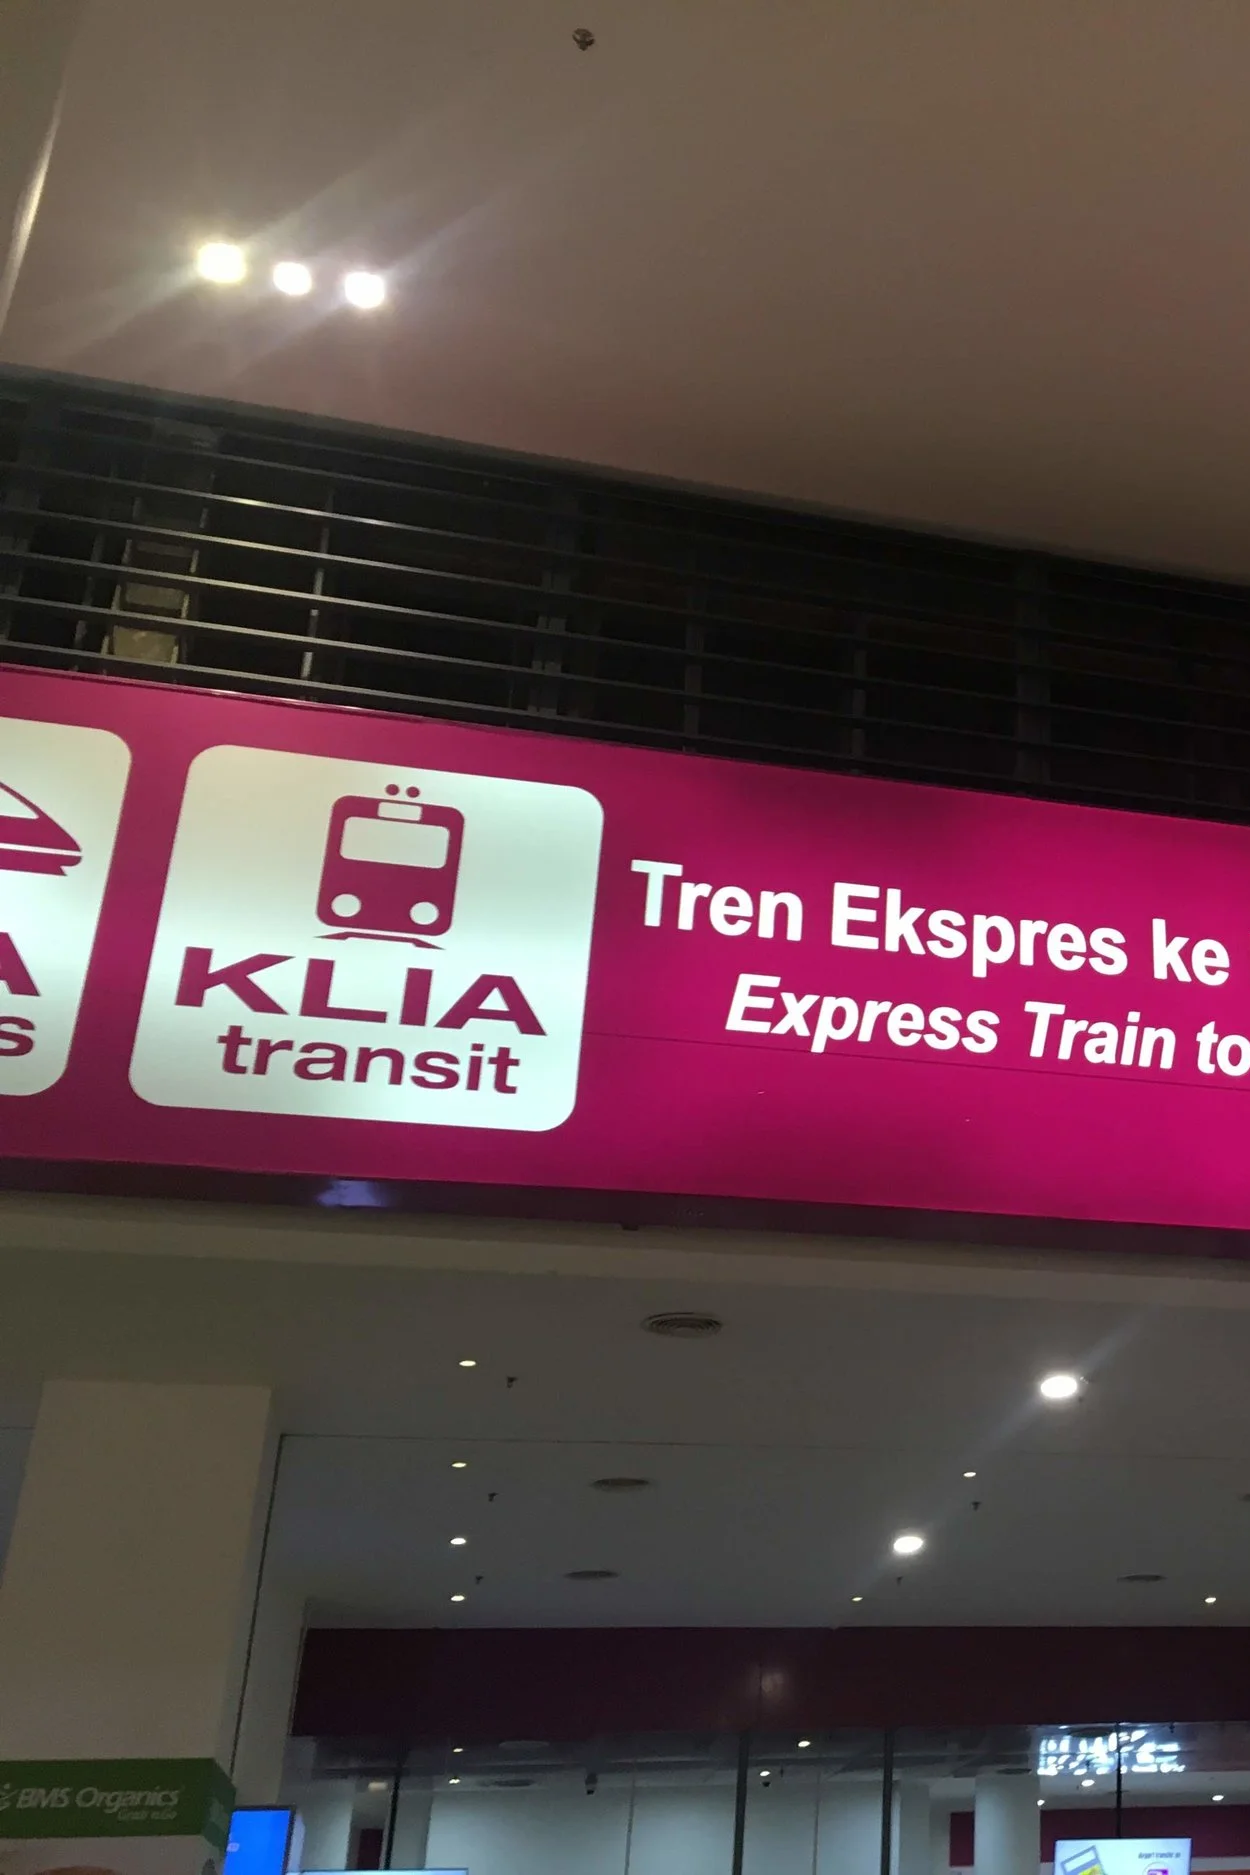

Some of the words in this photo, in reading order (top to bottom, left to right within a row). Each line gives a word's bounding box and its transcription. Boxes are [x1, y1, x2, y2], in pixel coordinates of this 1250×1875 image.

[630, 858, 803, 942] Tren
[830, 881, 1128, 978] Ekspres
[1152, 918, 1230, 986] ke
[174, 946, 548, 1037] KLIA
[725, 973, 1000, 1054] Express
[1023, 1000, 1176, 1070] Train
[217, 1024, 521, 1095] transit
[16, 1787, 73, 1809] BMS
[75, 1786, 180, 1814] Organics
